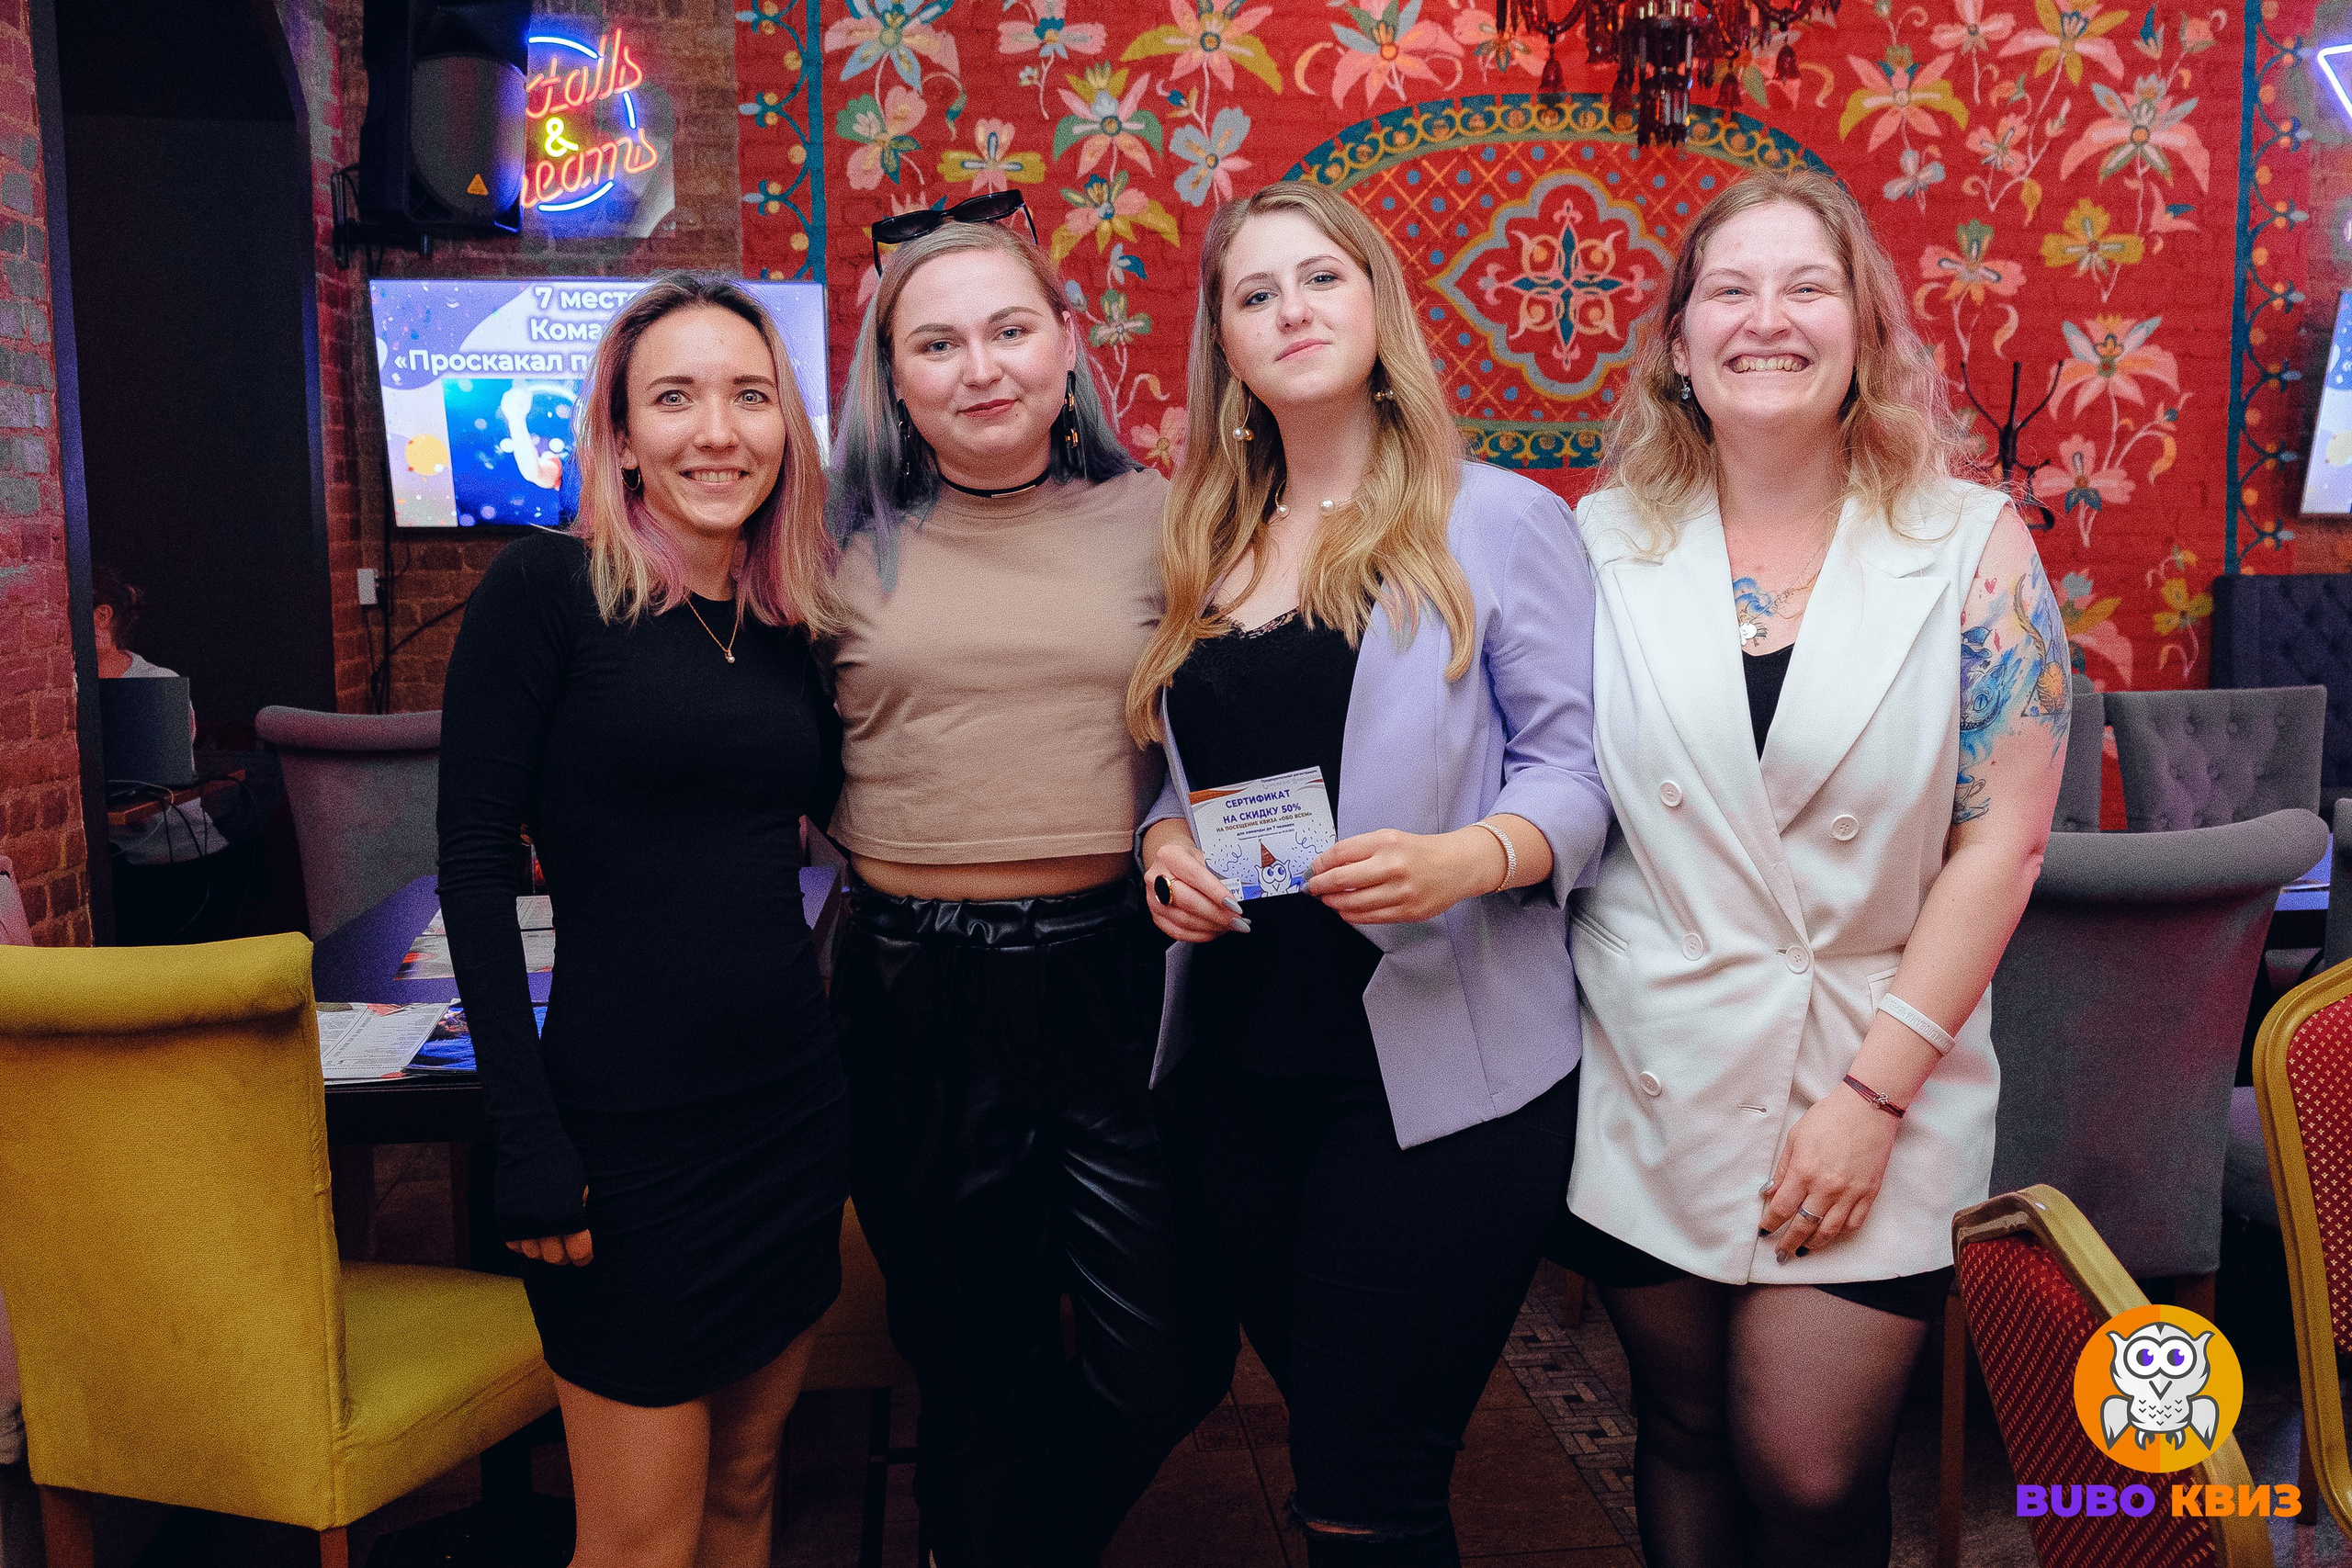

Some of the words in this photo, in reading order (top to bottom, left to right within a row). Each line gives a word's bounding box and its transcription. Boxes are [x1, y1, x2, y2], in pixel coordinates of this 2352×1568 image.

[545, 117, 580, 157] &
[535, 287, 553, 309] 7
[394, 349, 563, 376] «Проскакал
[1225, 789, 1291, 808] СЕРТИФИКАТ
[1223, 814, 1238, 824] НА
[1239, 807, 1279, 821] СКИДКУ
[1282, 803, 1302, 814] 50%
[1225, 821, 1259, 831] ПОСЕЩЕНИЕ
[1259, 817, 1278, 826] КВИЗА
